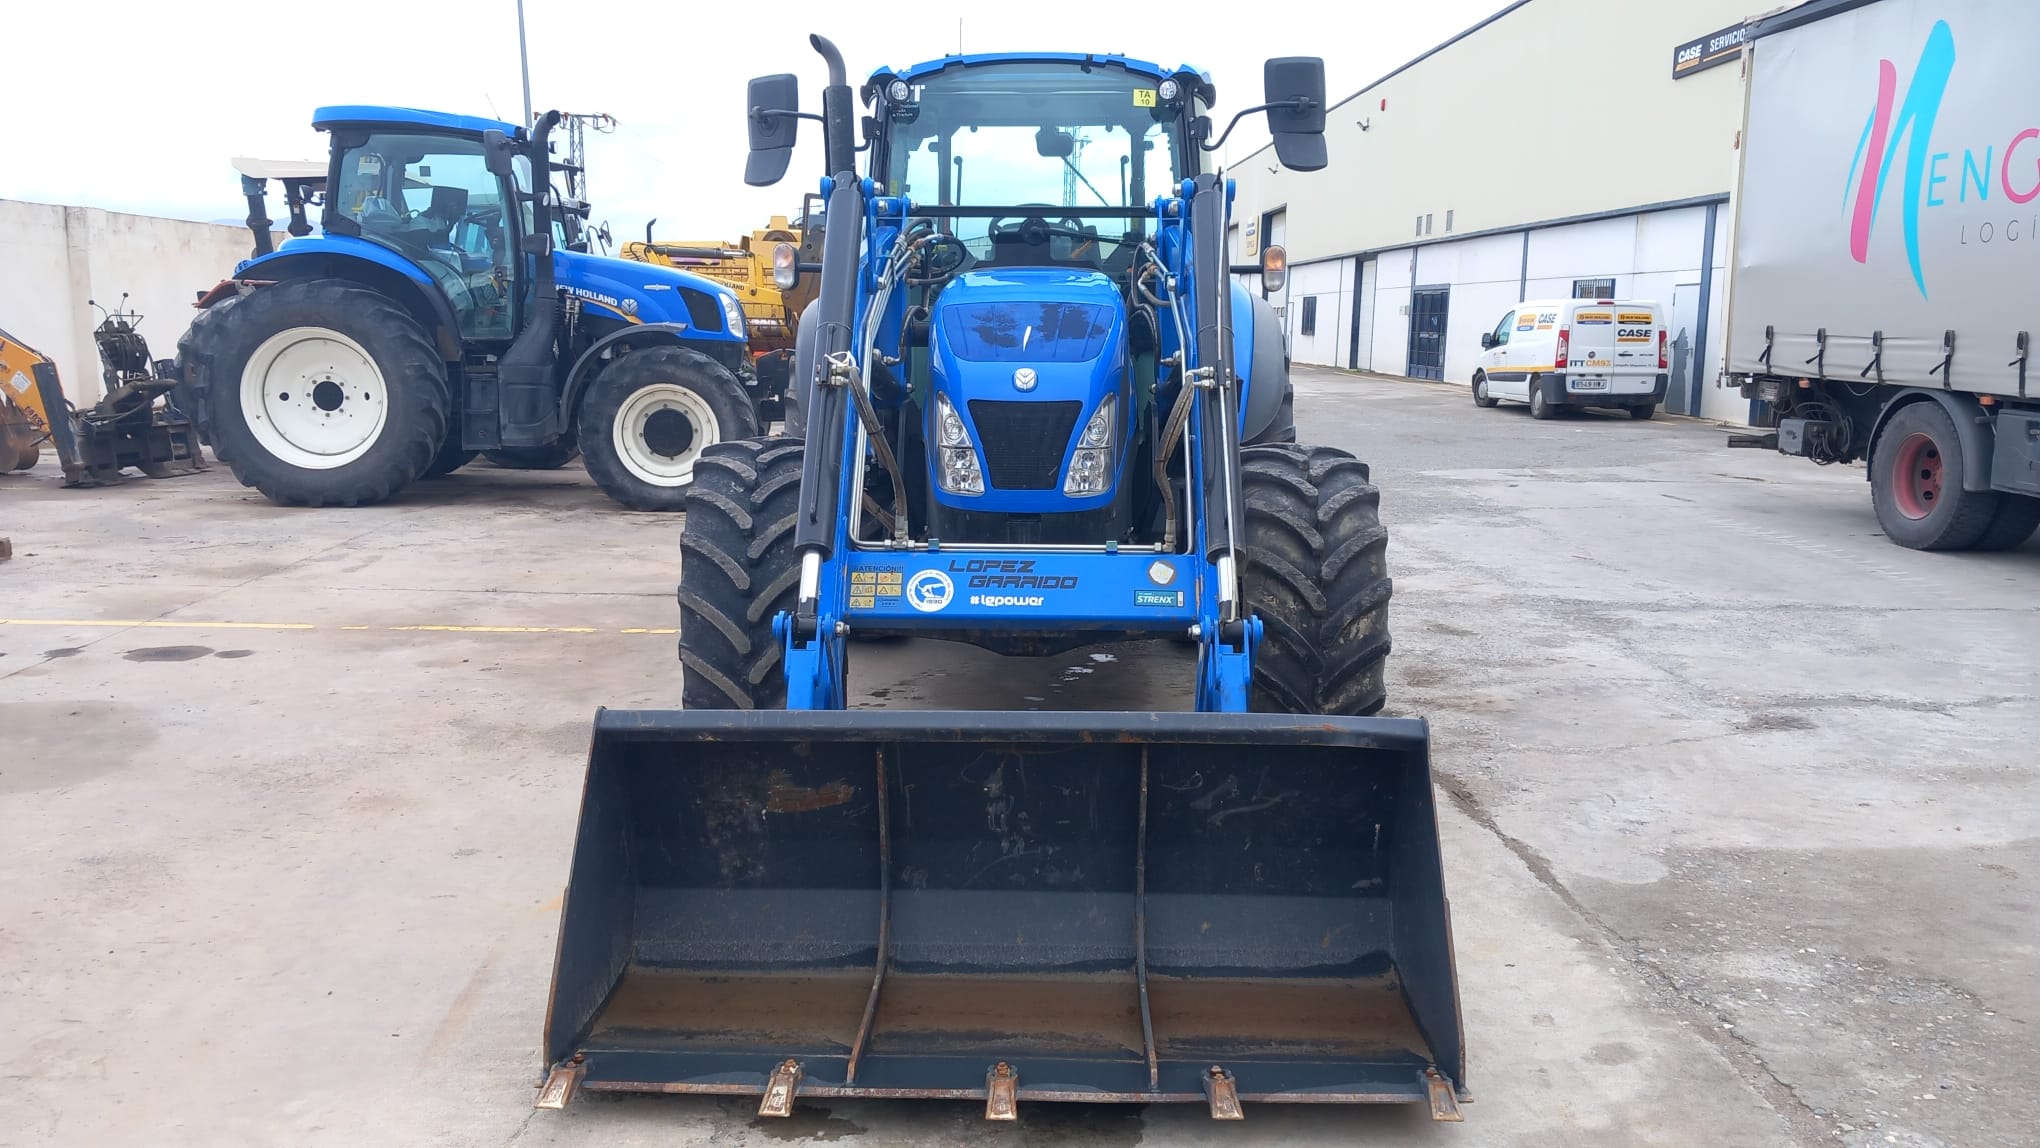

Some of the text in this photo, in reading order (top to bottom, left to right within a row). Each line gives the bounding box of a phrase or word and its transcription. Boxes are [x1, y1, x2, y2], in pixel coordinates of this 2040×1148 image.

[1678, 28, 1746, 63] CASE SERVICIO
[1138, 90, 1151, 98] TA
[576, 287, 618, 306] HOLLAND
[1538, 313, 1557, 323] CASE
[1617, 329, 1653, 338] CASE
[949, 559, 1037, 573] LOPEZ
[968, 575, 1078, 589] GARRIDO
[1137, 595, 1172, 604] STRENX
